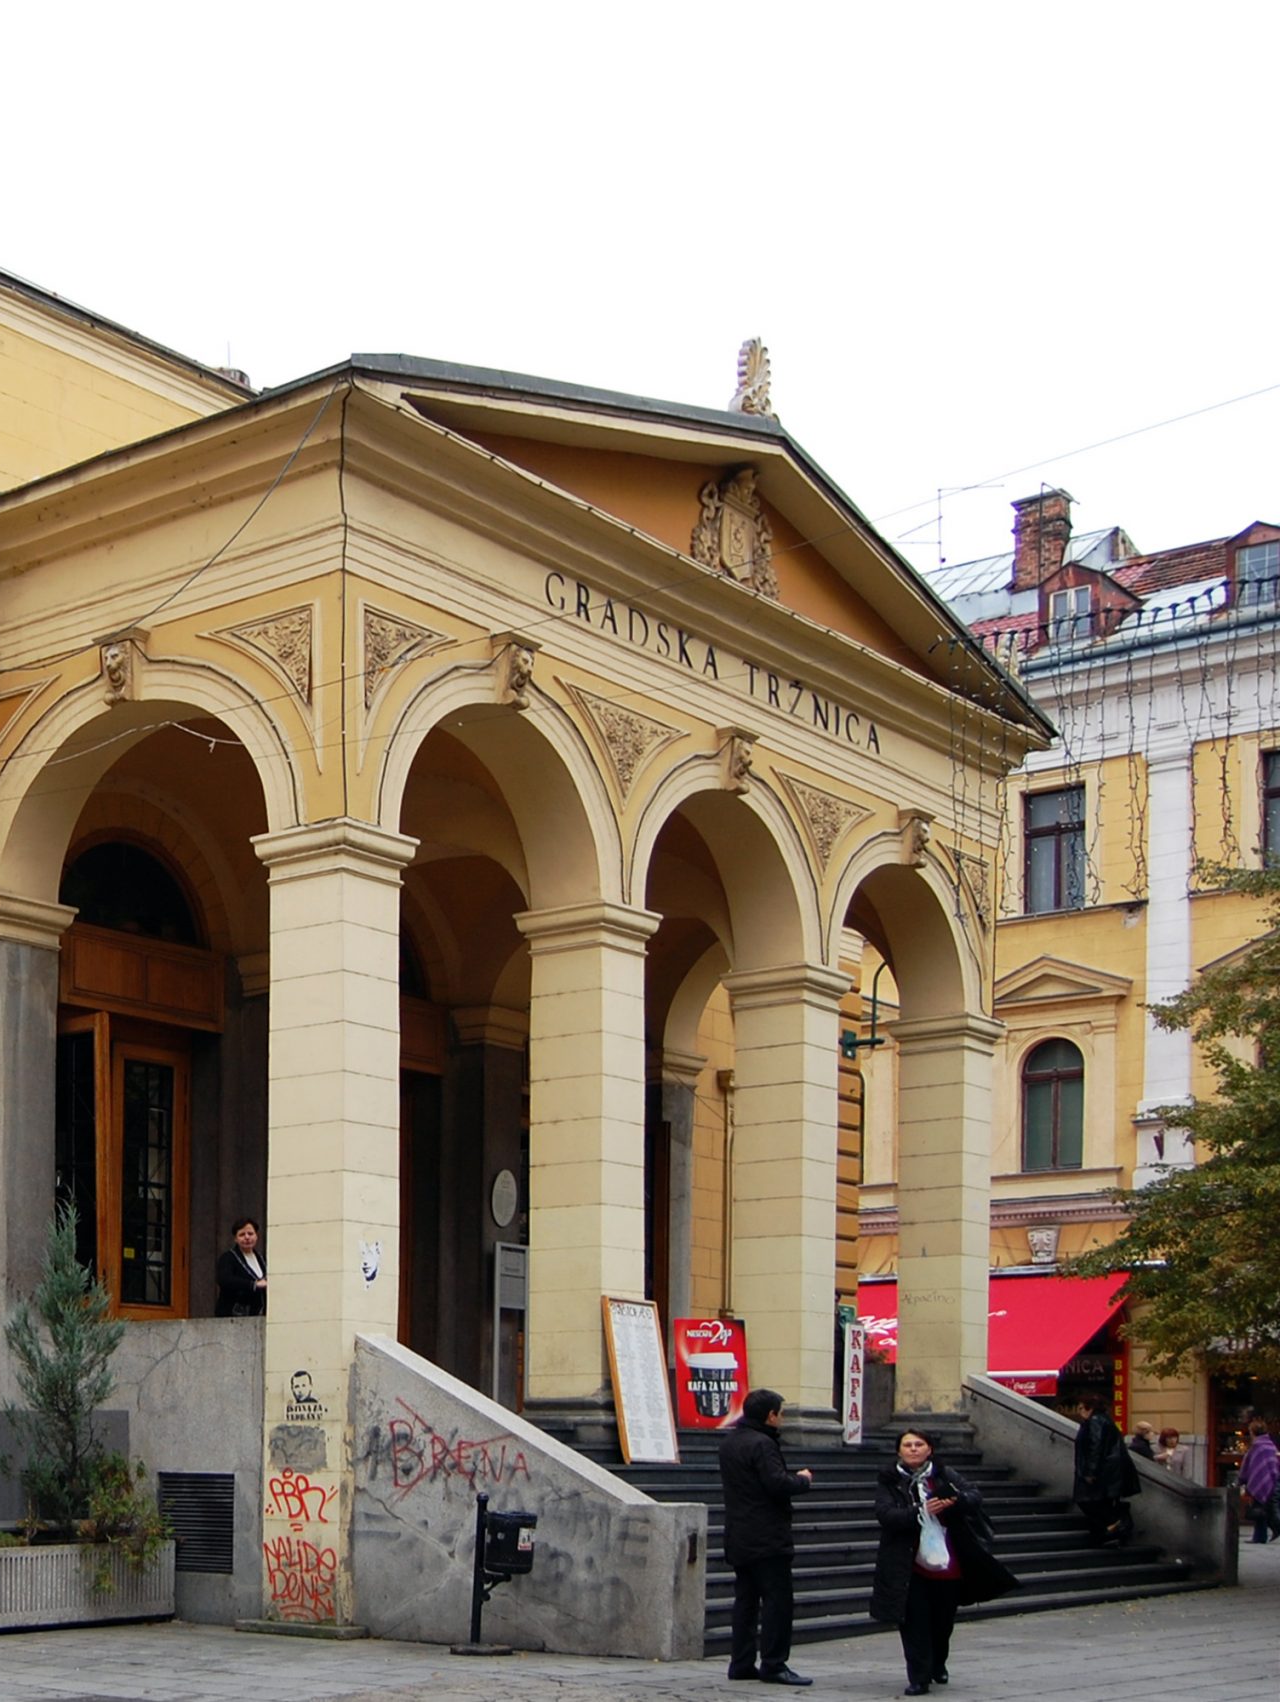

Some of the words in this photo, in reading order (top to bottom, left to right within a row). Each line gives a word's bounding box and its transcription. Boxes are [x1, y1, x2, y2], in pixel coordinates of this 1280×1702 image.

[545, 572, 719, 680] GRADSKA
[742, 659, 881, 755] TRŽNICA
[687, 1381, 707, 1391] KAFA
[708, 1381, 719, 1391] ZA
[849, 1330, 862, 1421] KAFA
[389, 1420, 532, 1488] BRENA
